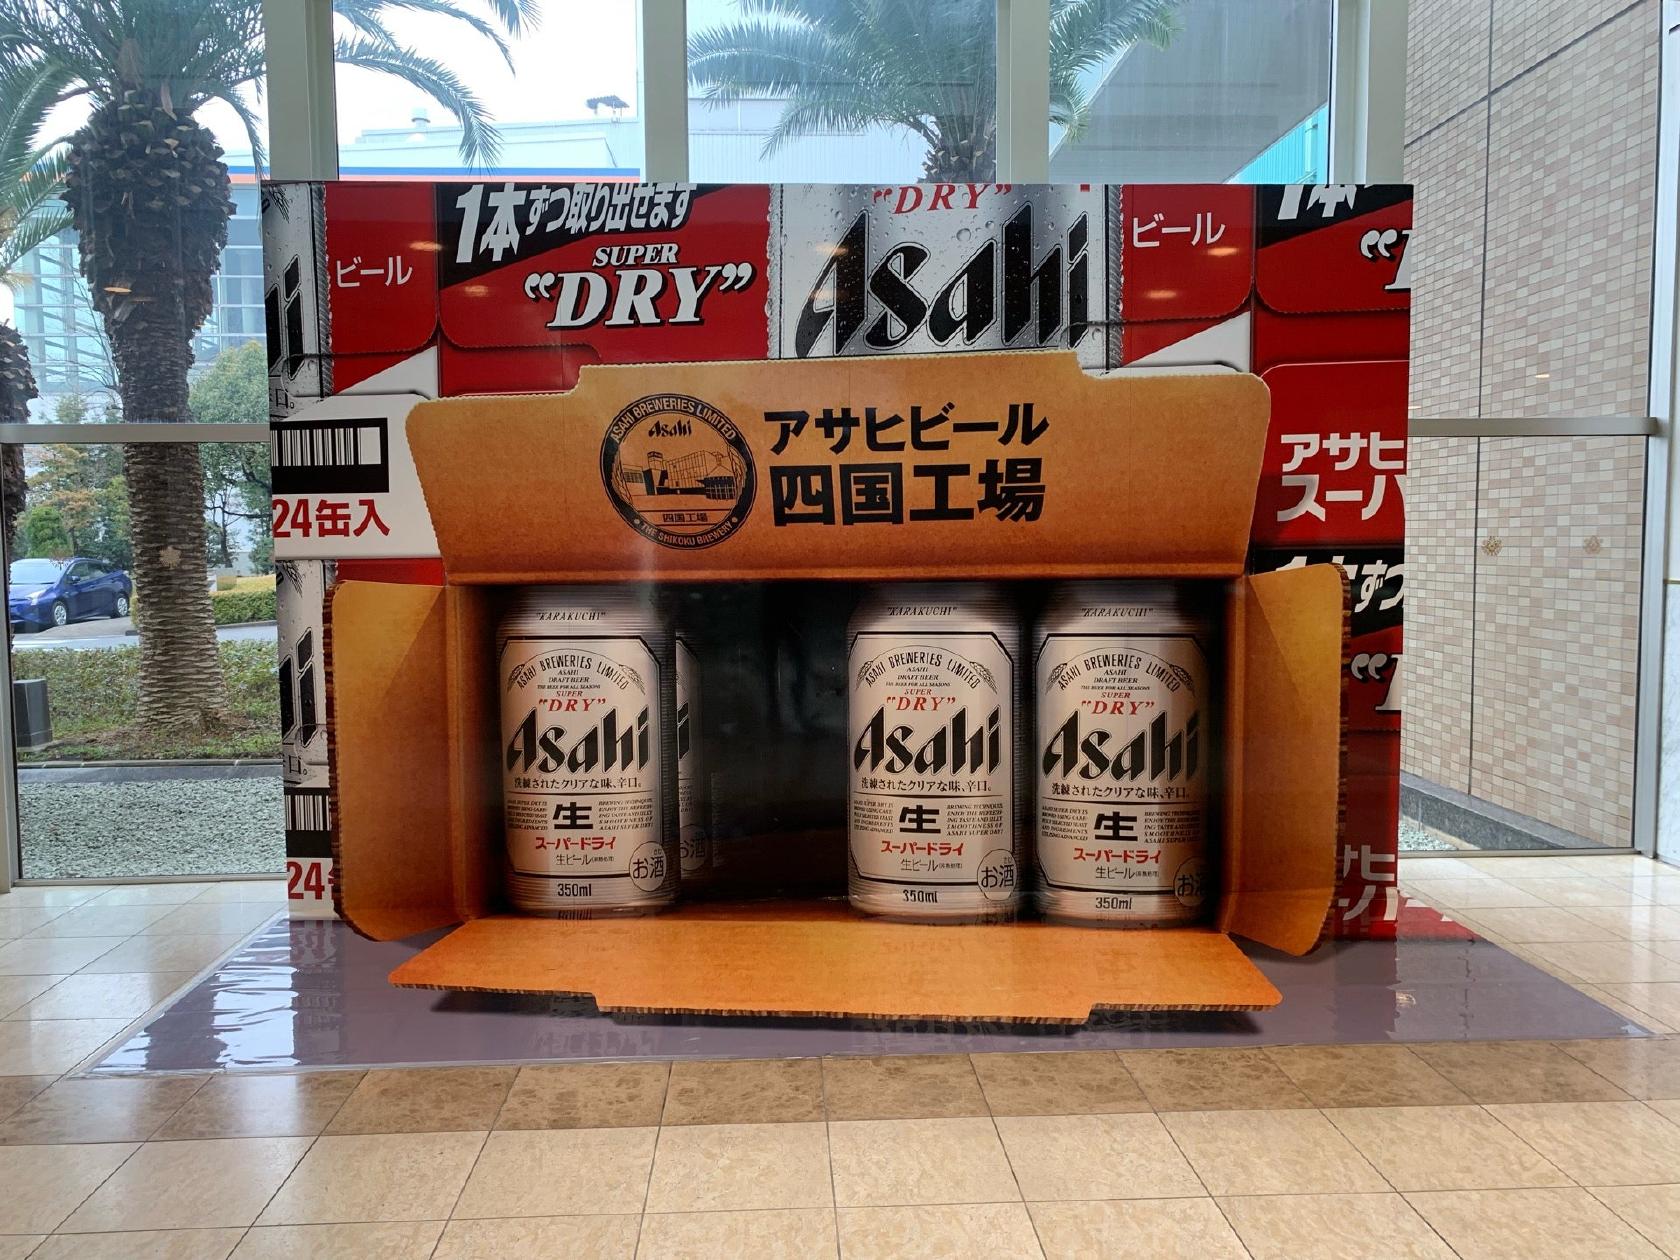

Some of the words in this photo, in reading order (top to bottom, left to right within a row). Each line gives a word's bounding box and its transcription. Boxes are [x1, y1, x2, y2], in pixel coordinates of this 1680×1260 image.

[1132, 213, 1225, 248] ビール
[592, 243, 680, 267] SUPER
[335, 256, 413, 289] ビール
[795, 200, 1090, 358] Asahi
[524, 262, 754, 328] “DRY”
[610, 412, 635, 443] ASAHI
[632, 397, 695, 419] BREWERIES
[695, 404, 737, 441] LIMITED
[648, 419, 692, 437] Asahi
[764, 401, 1051, 456] アサヒビール
[769, 457, 1047, 527] 四国工場
[272, 499, 390, 537] 24缶入
[641, 521, 657, 536] THE
[657, 531, 696, 545] SHIKOKU
[696, 520, 733, 545] BREWERY
[516, 665, 537, 690] ASAHI
[539, 654, 592, 671] BREWERIES
[597, 661, 629, 691] LIMITED
[865, 662, 886, 688] ASAHI
[888, 651, 943, 669] BREWERIES
[946, 658, 980, 690] LIMITED
[1058, 664, 1081, 691] ASAHI
[1083, 653, 1142, 671] BREWERIES
[1145, 661, 1180, 693] LIMITED
[555, 690, 583, 698] SUPER
[904, 688, 932, 696] SUPER
[506, 704, 650, 773] Asahi
[854, 705, 1000, 775] Asahi
[1043, 708, 1200, 781] Asahi
[552, 802, 593, 830] 生
[899, 804, 941, 834] 生
[1093, 811, 1138, 841] 生
[535, 836, 616, 850] スーパードライ
[881, 840, 964, 856] スーパードライ
[1073, 848, 1161, 864] スーパードライ
[632, 855, 664, 879] お酒
[980, 864, 1014, 888] お酒
[557, 883, 592, 897] 350ml
[902, 889, 938, 903] 350ml
[1095, 897, 1132, 910] 350ml
